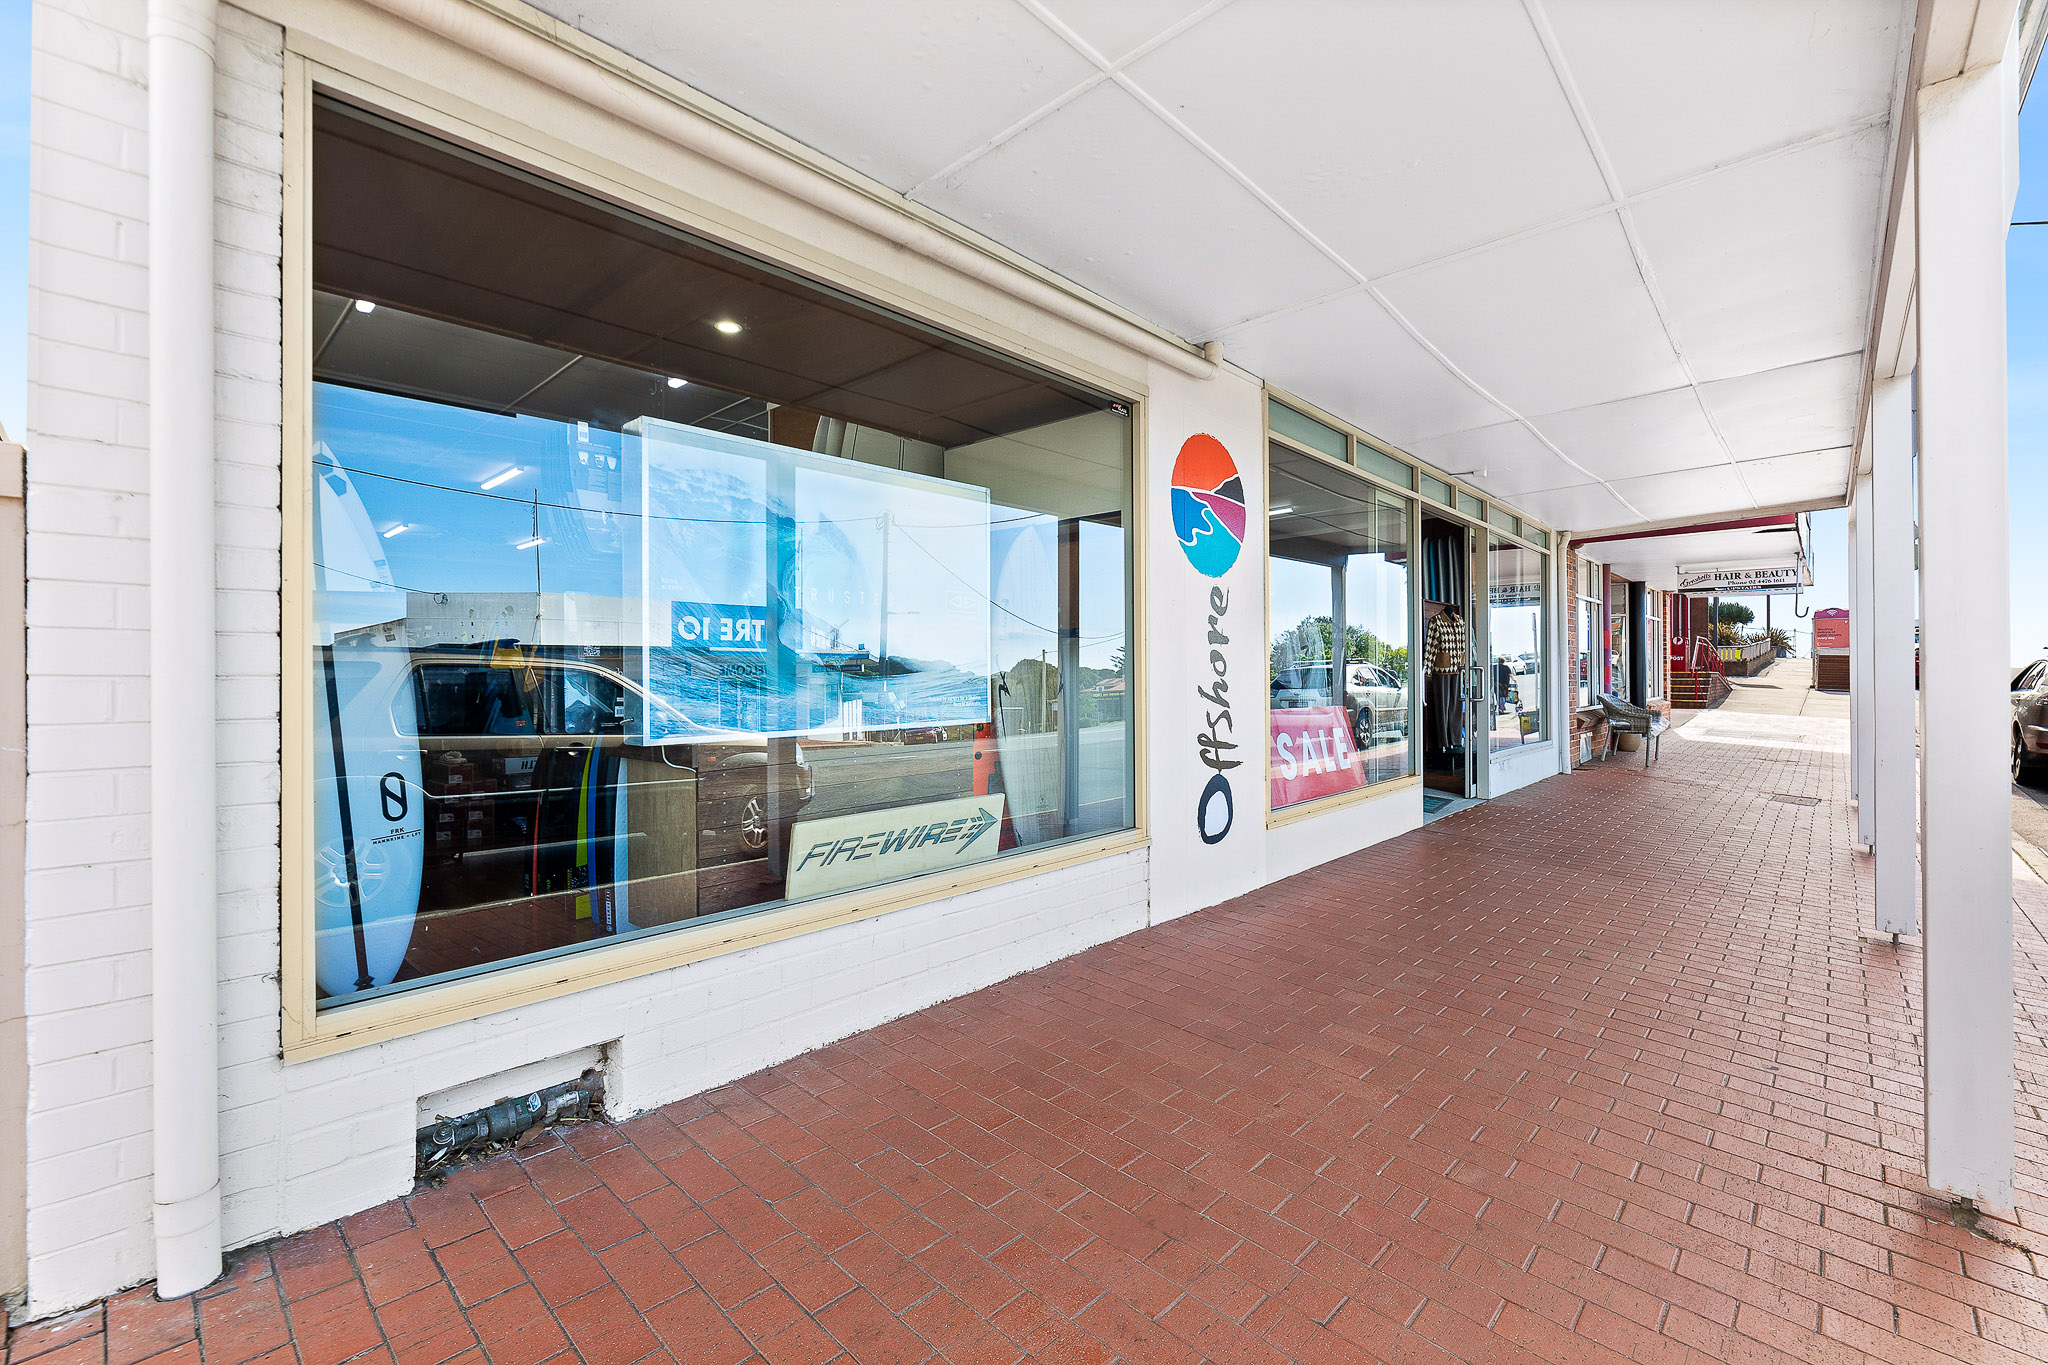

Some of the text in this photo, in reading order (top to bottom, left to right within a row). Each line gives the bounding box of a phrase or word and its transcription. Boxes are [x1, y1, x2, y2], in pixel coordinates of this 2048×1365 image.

[795, 586, 895, 607] TRUSTED
[1714, 572, 1741, 581] HAIR
[1744, 571, 1752, 579] &
[1754, 569, 1798, 579] BEAUTY
[1197, 583, 1243, 845] Offshore
[1276, 727, 1351, 781] SALE
[796, 818, 969, 872] FIREWIRE
